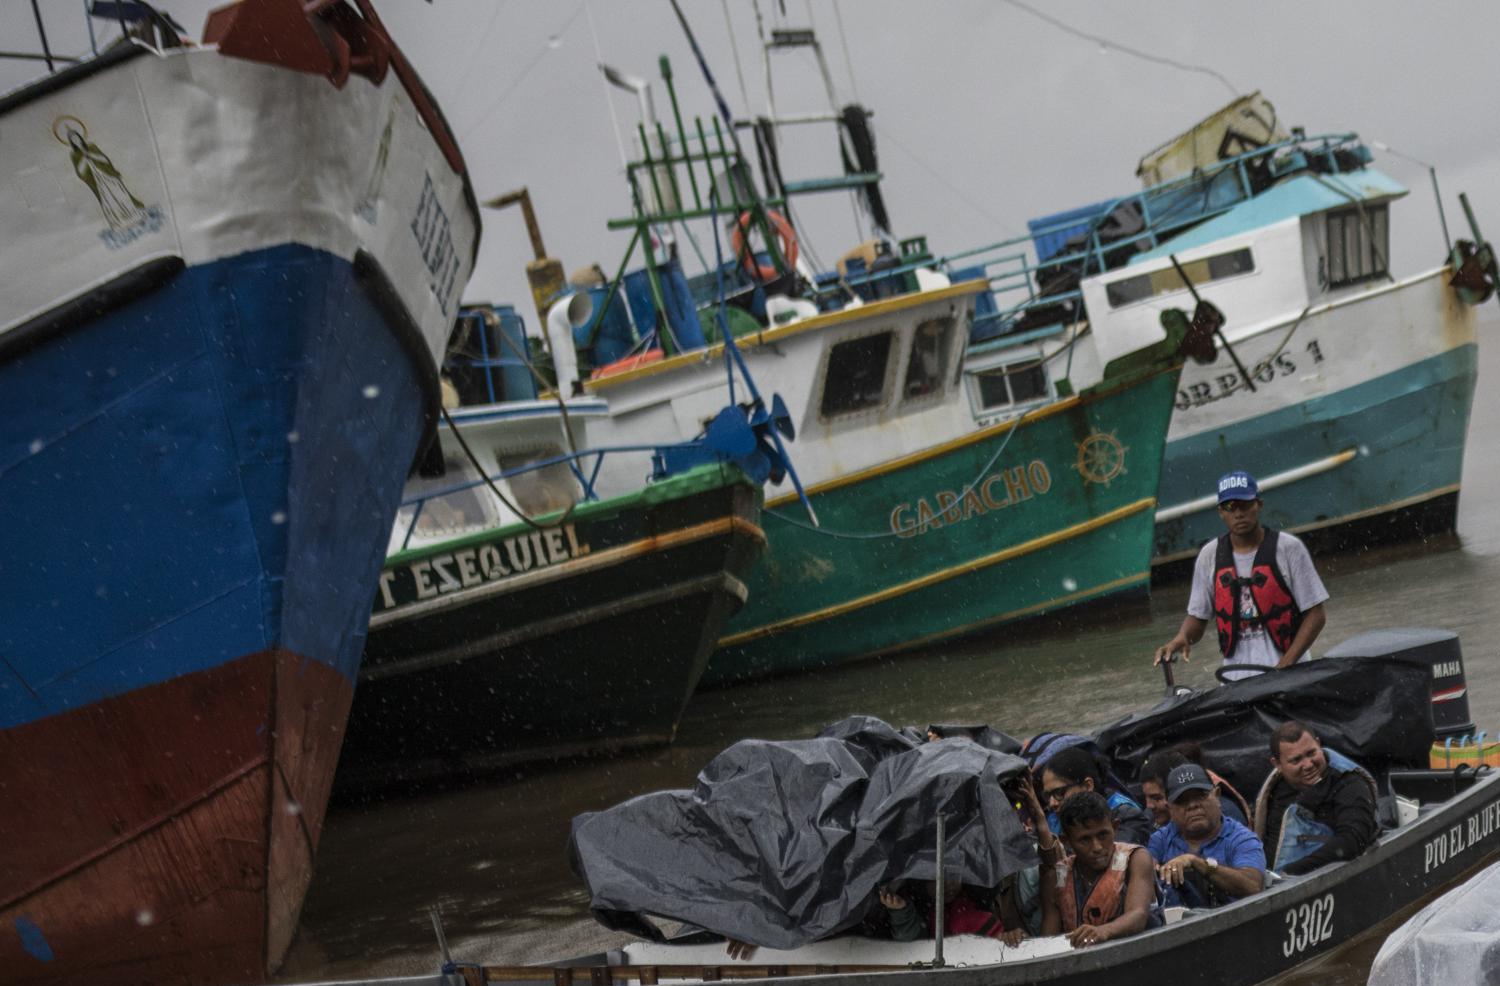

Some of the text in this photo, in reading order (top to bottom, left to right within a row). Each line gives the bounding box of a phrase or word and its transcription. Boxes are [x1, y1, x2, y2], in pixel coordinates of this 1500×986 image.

[890, 459, 1051, 538] GABACHO
[1433, 661, 1461, 678] MAHA
[1424, 833, 1448, 873] PTO
[1449, 821, 1466, 858] EL
[1283, 893, 1335, 957] 3302
